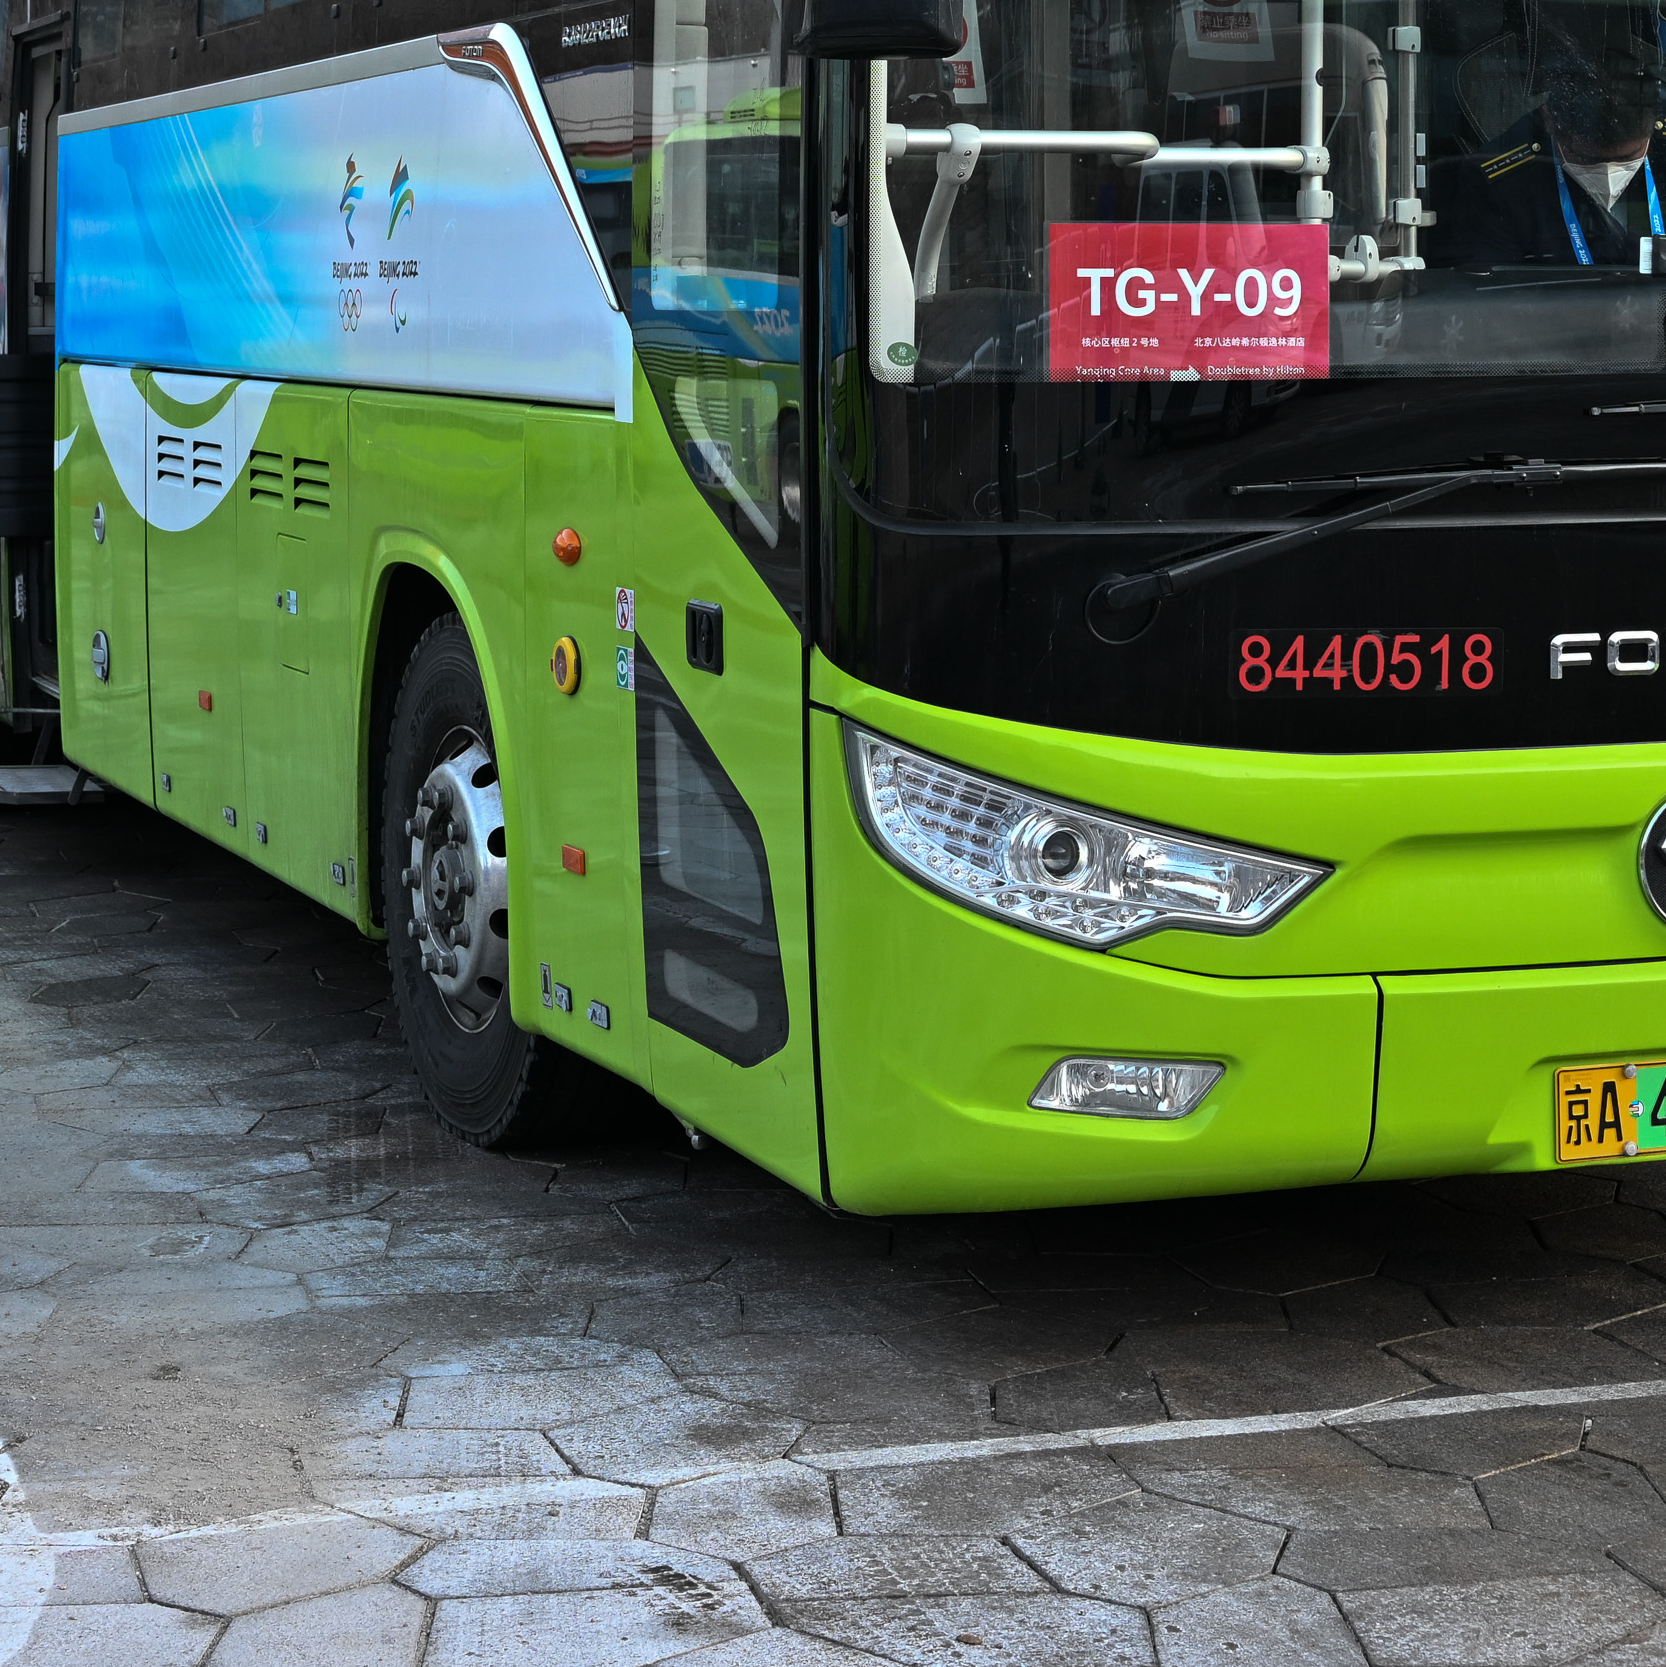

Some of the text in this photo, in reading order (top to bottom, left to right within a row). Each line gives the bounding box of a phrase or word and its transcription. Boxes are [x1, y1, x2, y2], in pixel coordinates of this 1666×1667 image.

[1569, 223, 1583, 249] BEIJING
[332, 261, 369, 284] BEIJING 2022
[378, 260, 419, 284] BEIJING 2022
[1076, 267, 1302, 317] TG-Y-09
[1194, 337, 1305, 348] 北京八达岭希尔顿逸林酒店
[1075, 365, 1116, 378] Yanqing
[1238, 633, 1494, 692] 8440518
